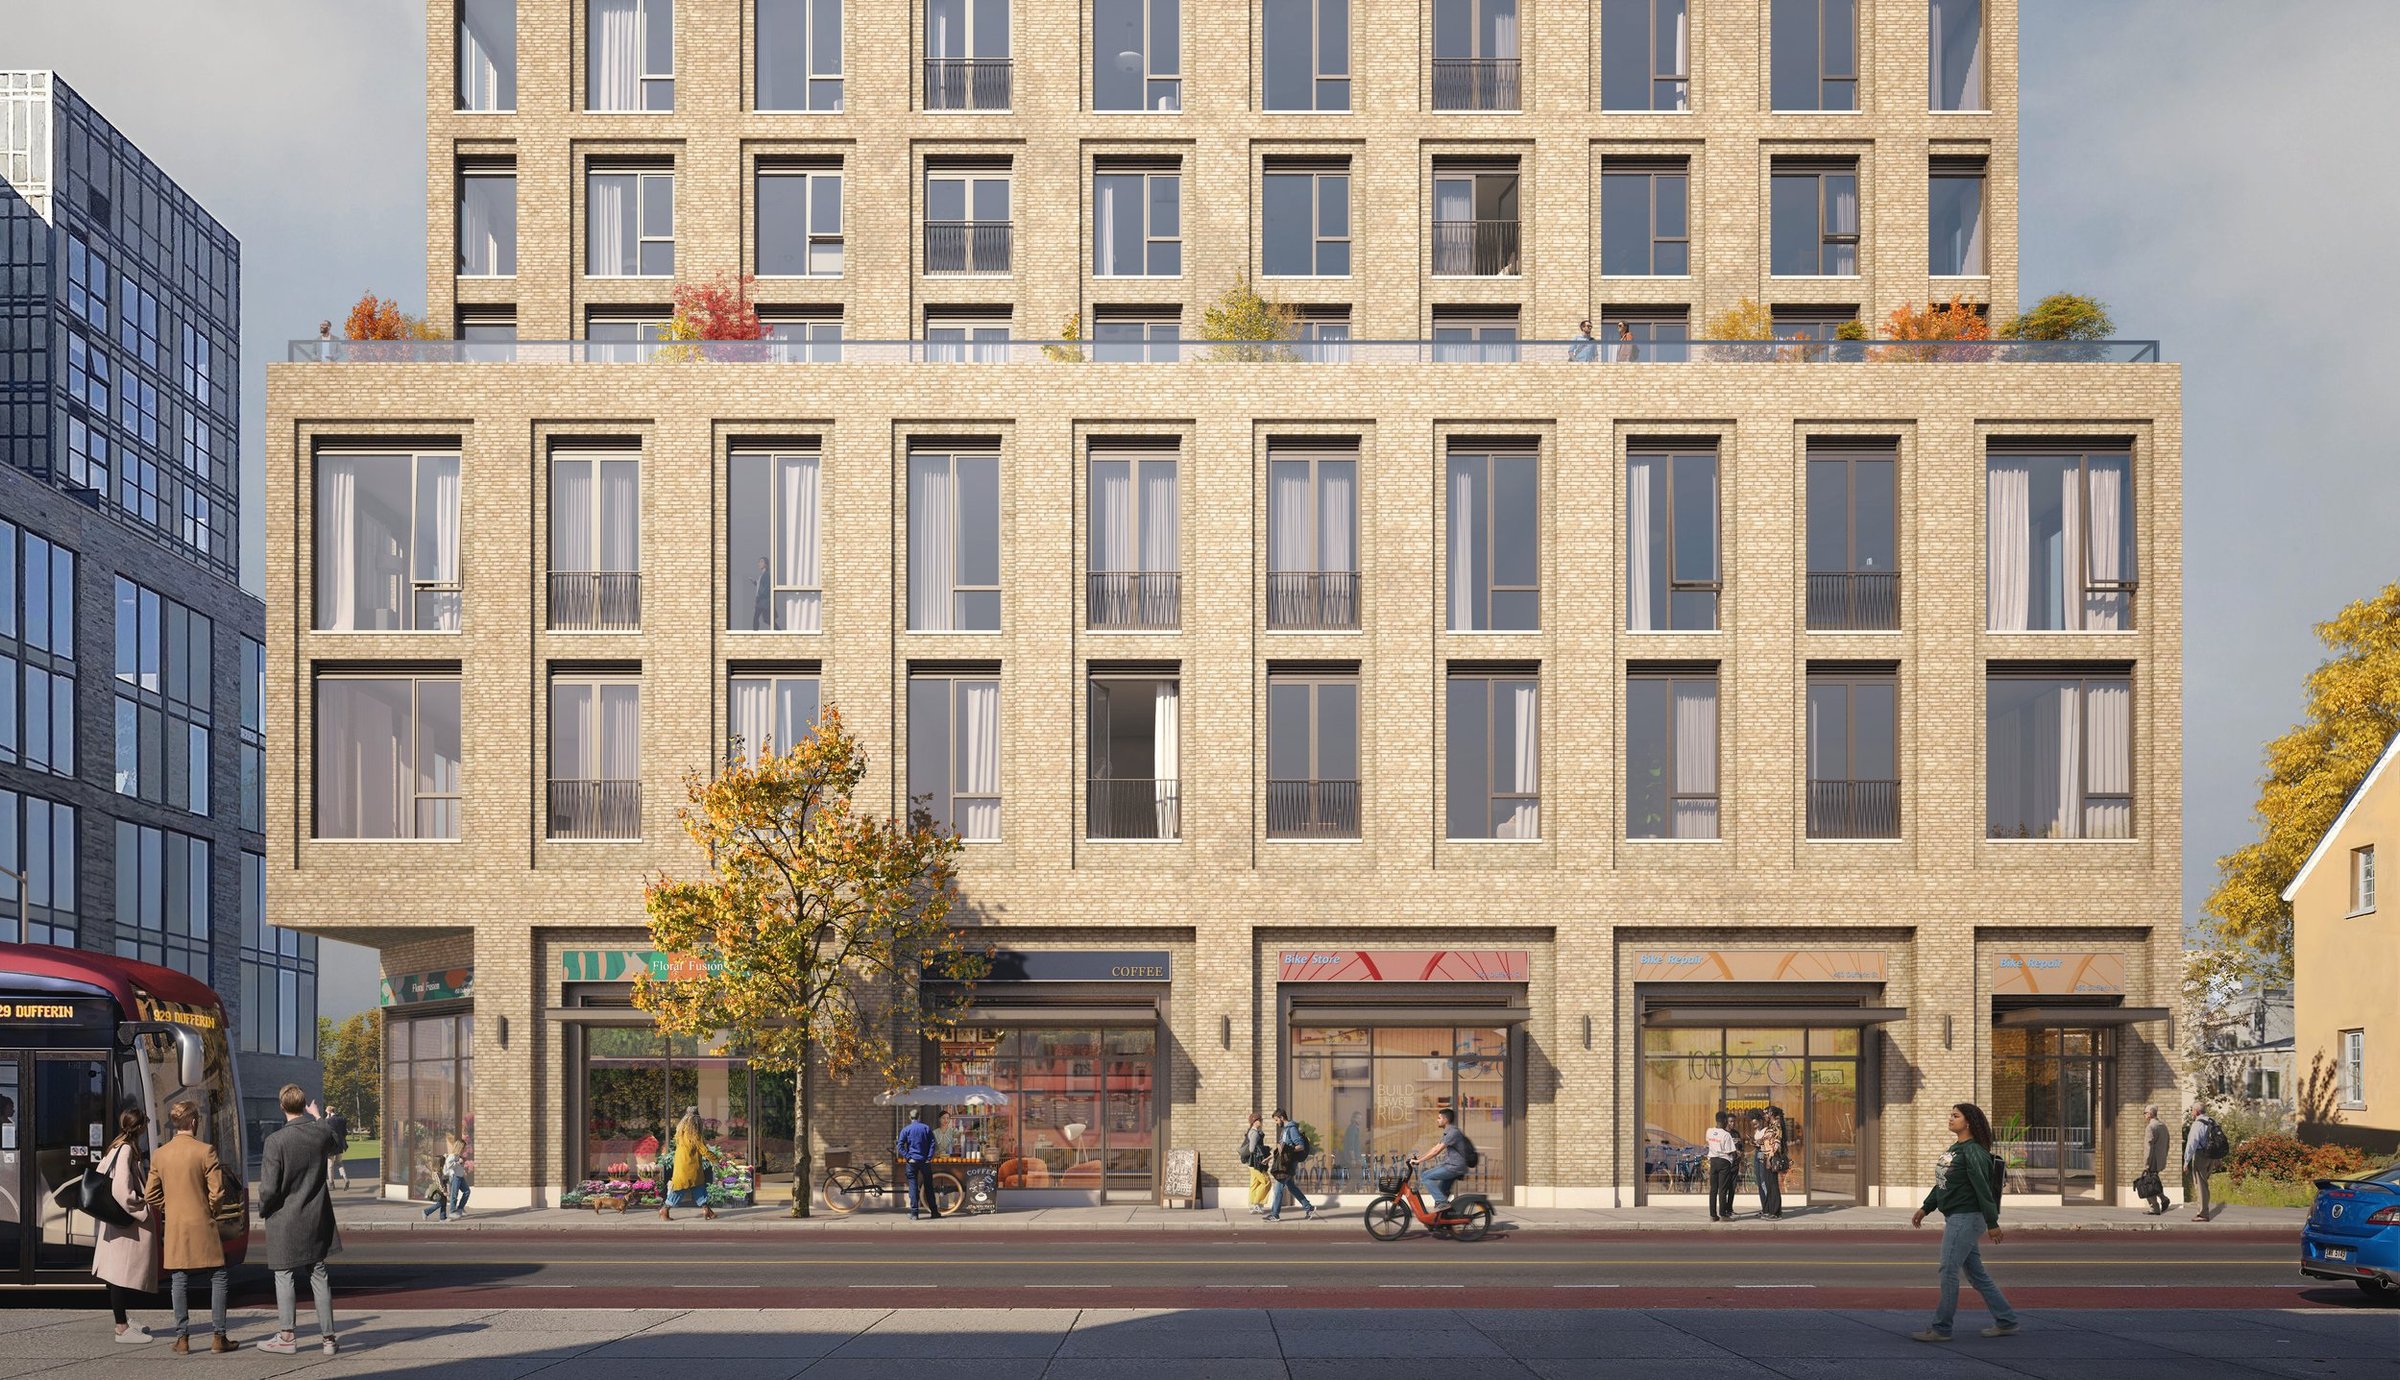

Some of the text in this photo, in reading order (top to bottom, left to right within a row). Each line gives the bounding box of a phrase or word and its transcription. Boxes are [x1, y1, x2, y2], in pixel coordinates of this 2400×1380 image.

[1284, 954, 1341, 964] Bike Store
[1999, 958, 2023, 968] Bike
[1112, 966, 1163, 977] COFFEE
[16, 1005, 74, 1018] DUFFERIN
[153, 1009, 215, 1029] 929 DUFFERIN
[1377, 1084, 1414, 1097] BUILD
[1377, 1105, 1414, 1121] RIDE
